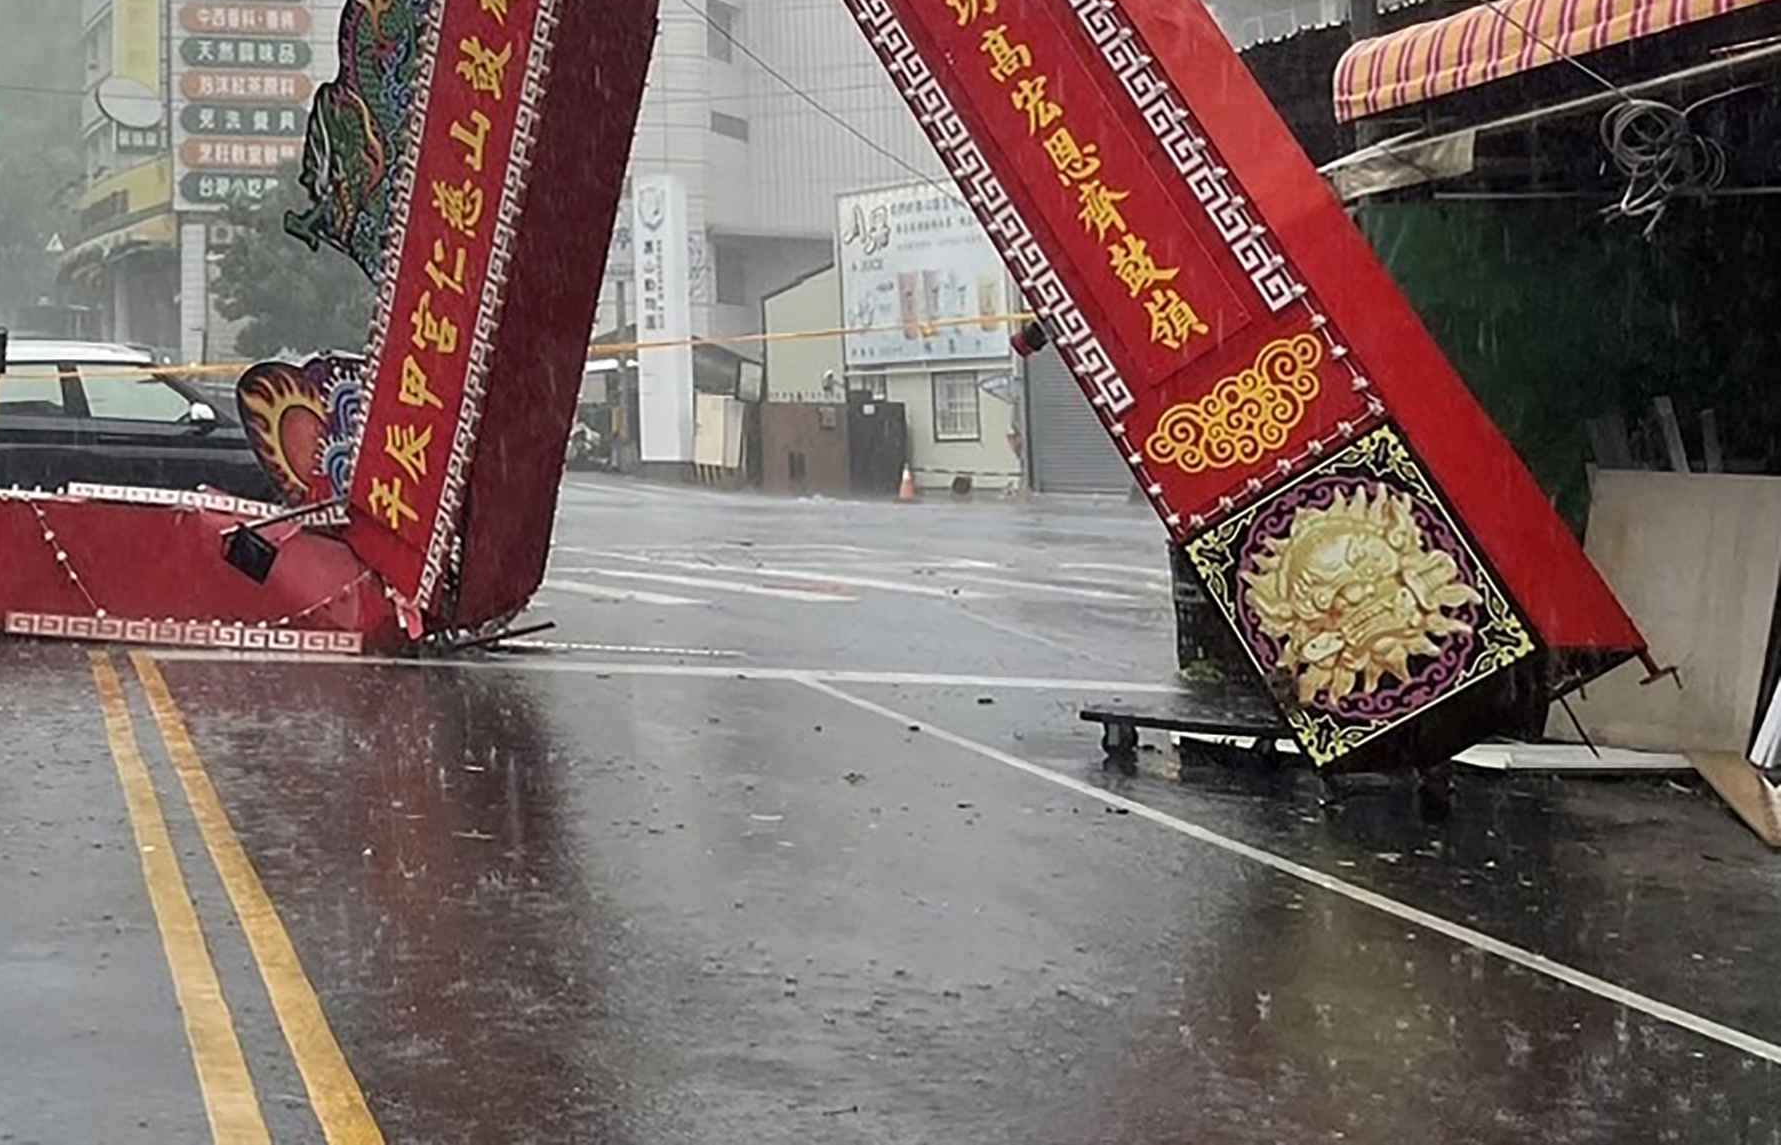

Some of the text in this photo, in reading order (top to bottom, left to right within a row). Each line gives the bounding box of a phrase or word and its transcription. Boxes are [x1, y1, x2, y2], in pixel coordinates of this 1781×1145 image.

[197, 40, 296, 64] 天然調味品
